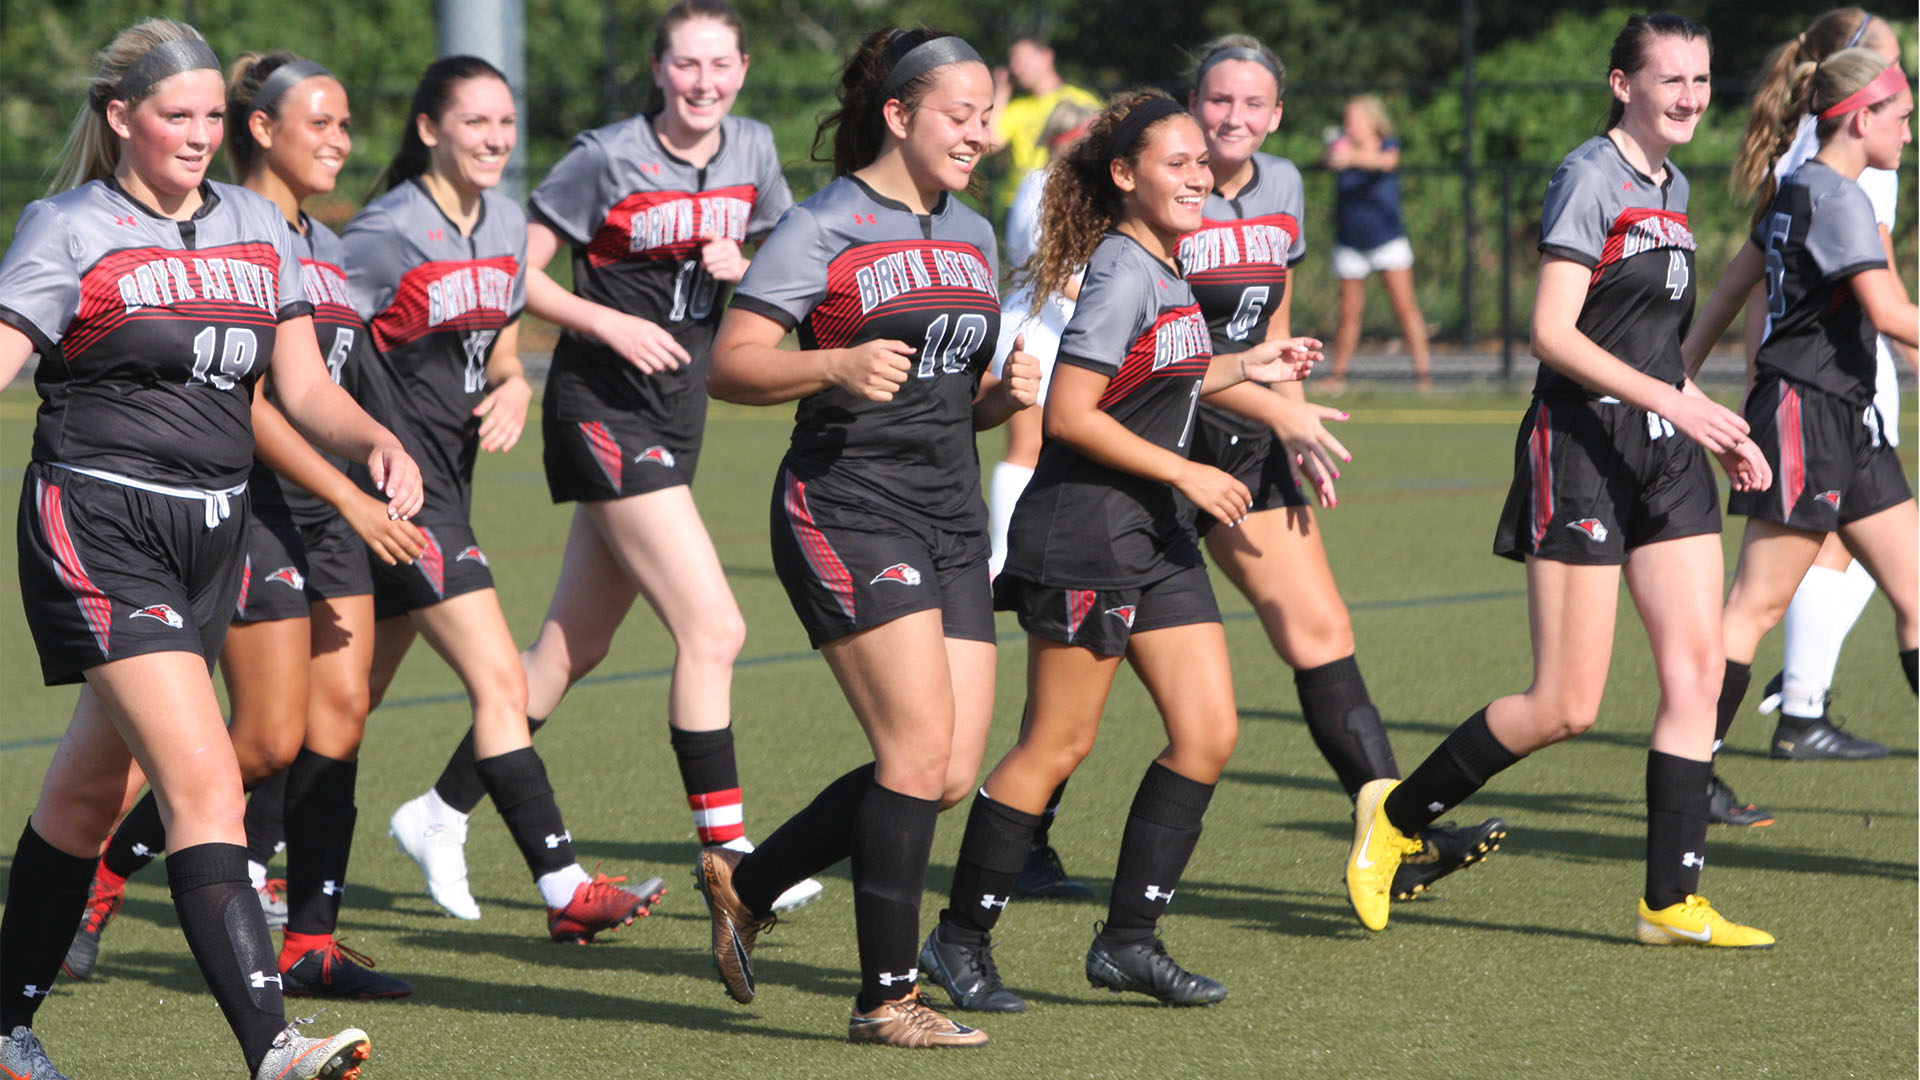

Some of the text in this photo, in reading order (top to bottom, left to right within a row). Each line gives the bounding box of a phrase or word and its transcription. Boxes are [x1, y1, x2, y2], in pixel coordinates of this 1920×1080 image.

[629, 198, 693, 253] BRYN
[1178, 227, 1240, 276] BRYN
[427, 266, 478, 328] BRYN
[855, 249, 932, 315] BRYN
[1665, 249, 1689, 301] 4
[1226, 286, 1270, 341] 6
[185, 326, 258, 391] 19
[917, 313, 988, 379] 10
[1177, 379, 1203, 448] 1
